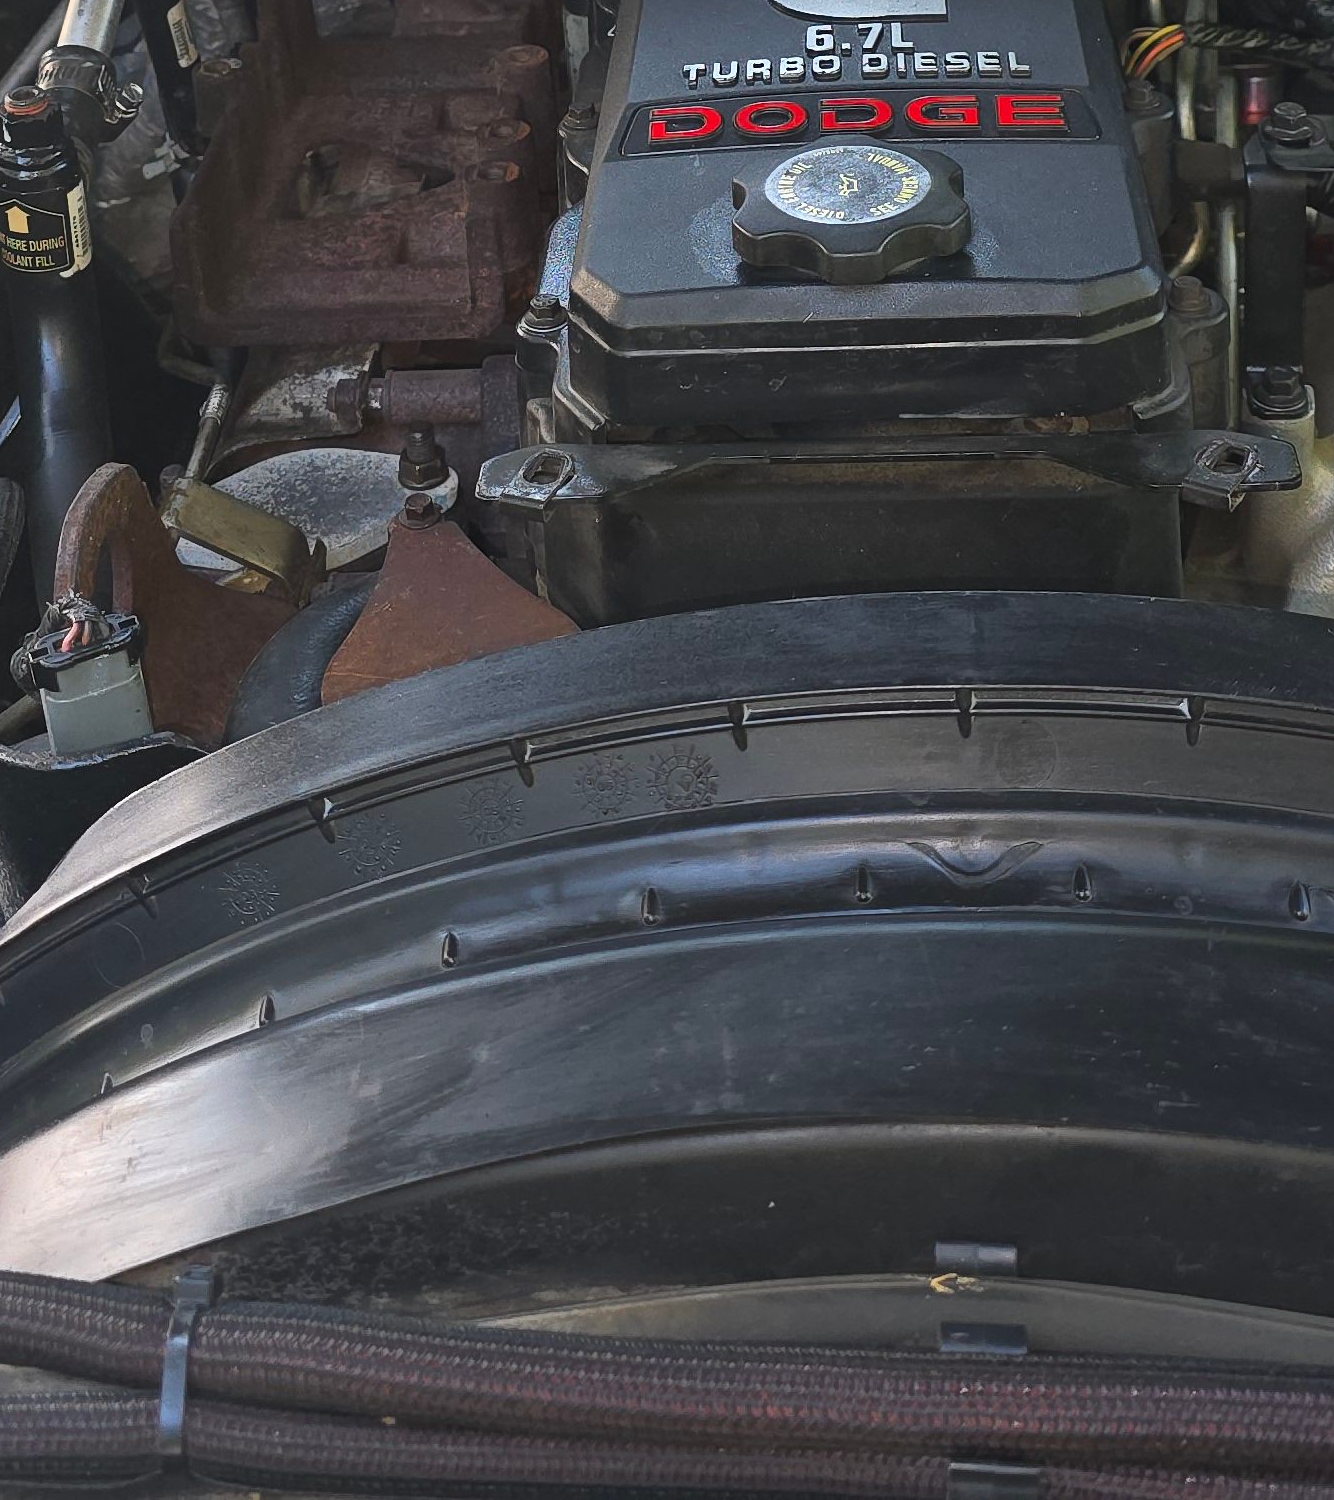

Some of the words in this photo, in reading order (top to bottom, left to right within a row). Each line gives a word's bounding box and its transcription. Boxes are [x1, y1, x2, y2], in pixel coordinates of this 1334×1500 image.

[805, 22, 916, 56] 6.7L
[683, 55, 842, 89] TURBO
[861, 50, 1032, 80] DIESEL
[648, 93, 1070, 146] DODGE
[6, 236, 28, 252] HERE
[29, 235, 65, 252] DURING
[35, 254, 55, 268] FILL
